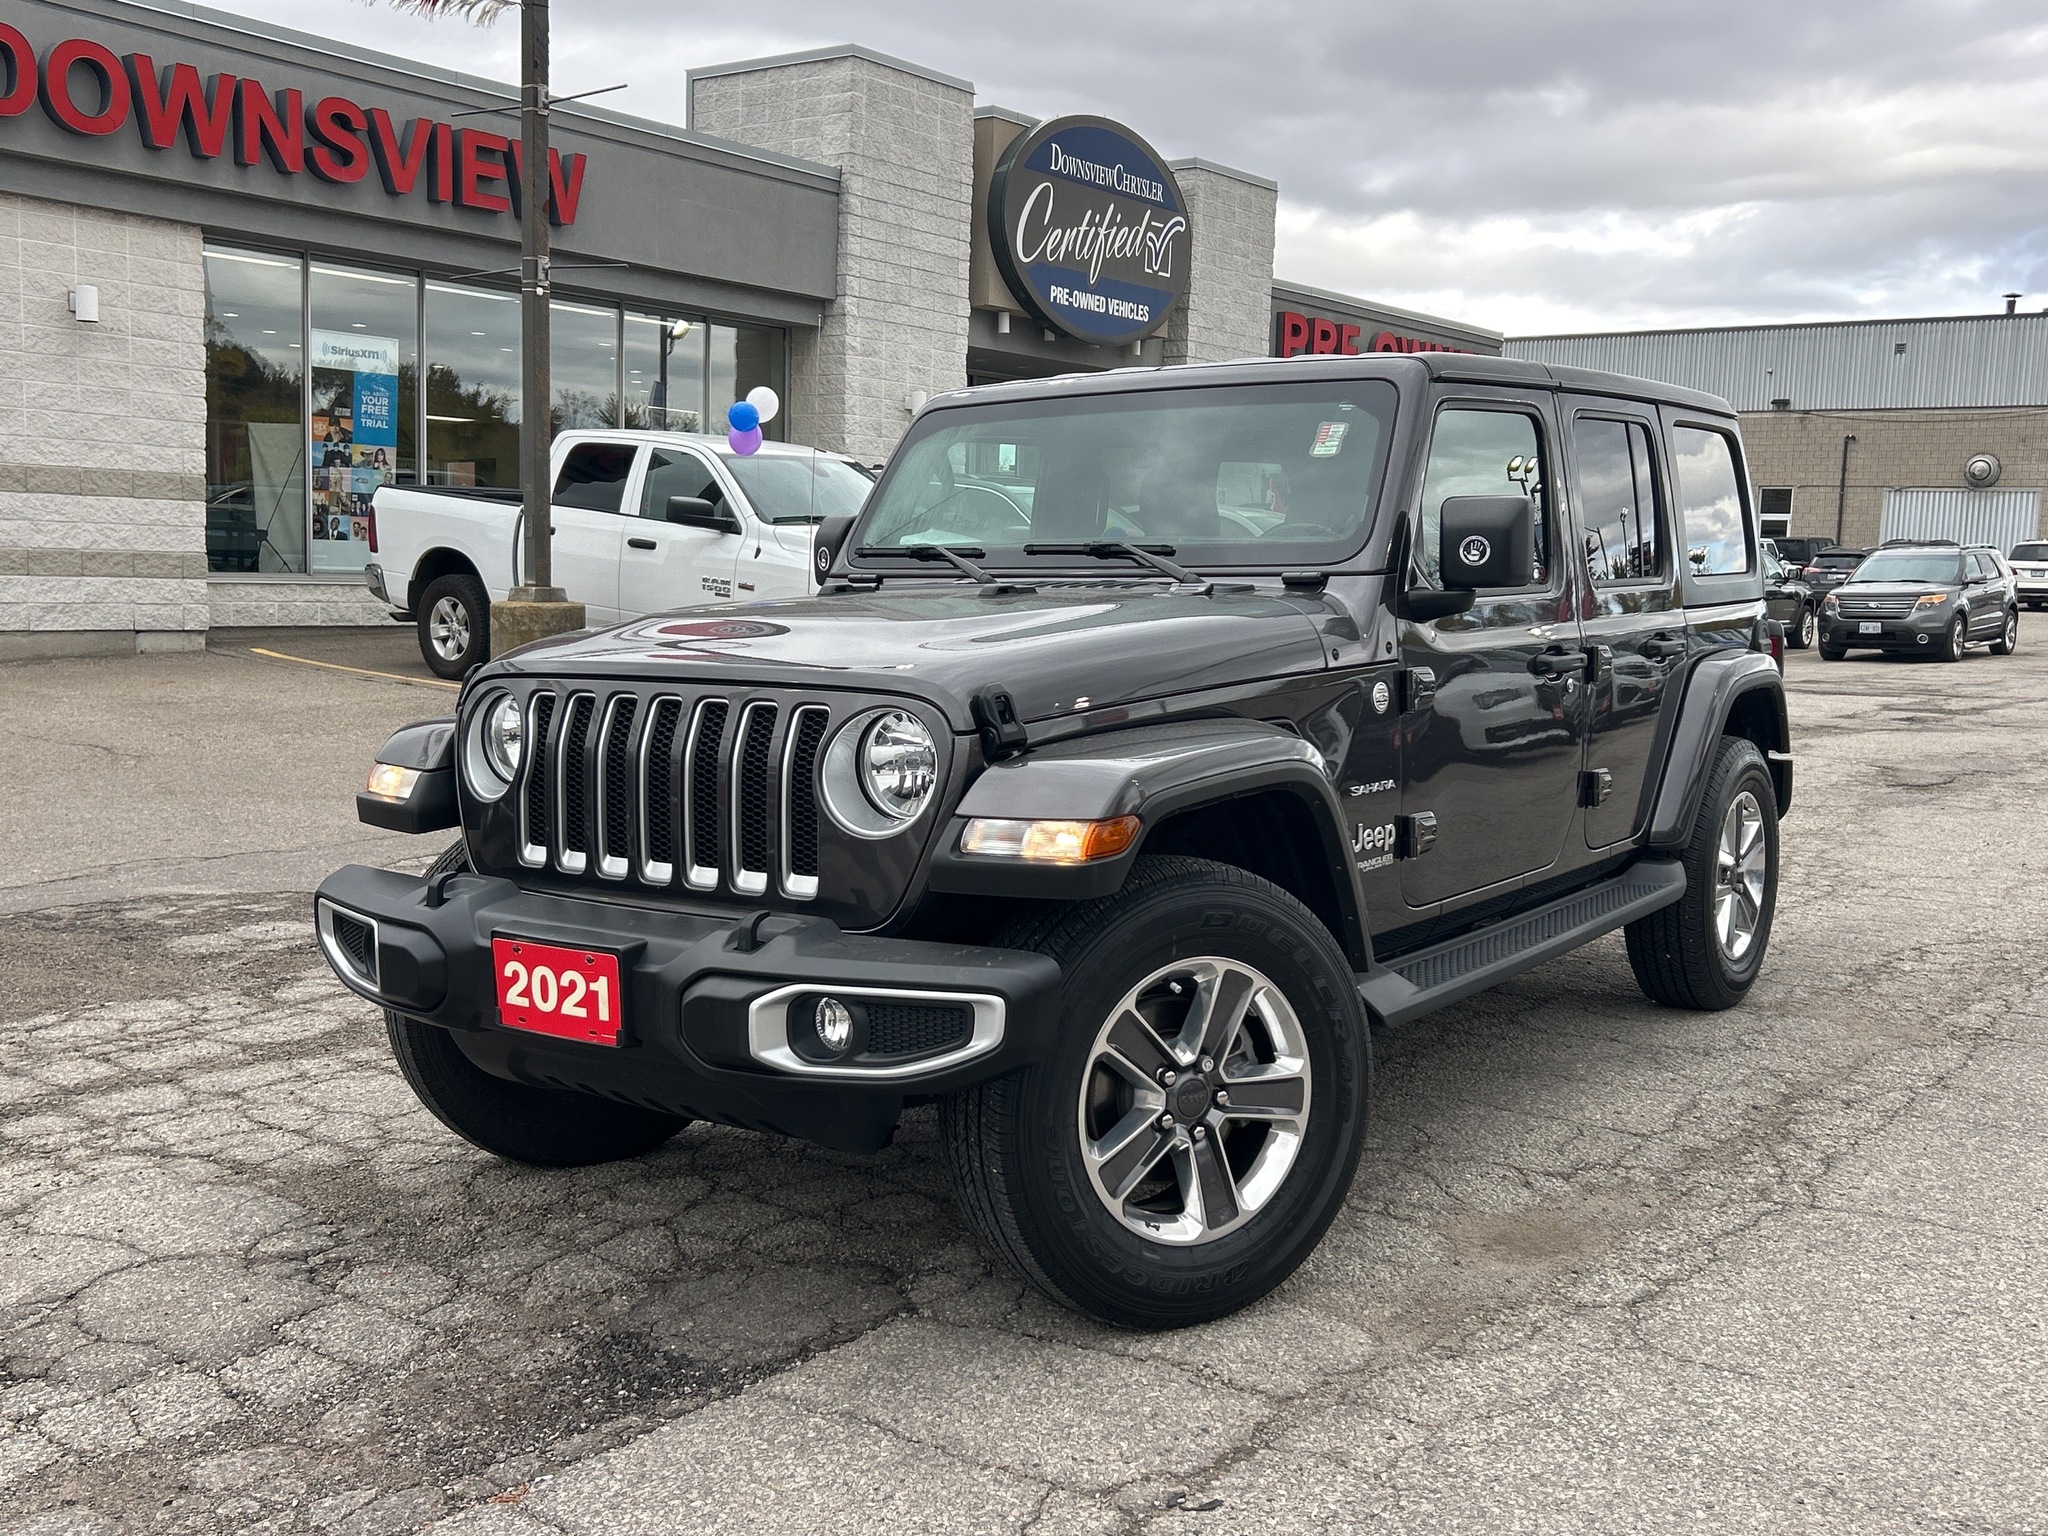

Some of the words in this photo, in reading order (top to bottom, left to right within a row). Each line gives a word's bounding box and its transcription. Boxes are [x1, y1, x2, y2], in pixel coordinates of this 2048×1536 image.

[1016, 182, 1152, 285] Certified
[1050, 285, 1106, 313] PRE-OWNED
[1107, 297, 1150, 322] VEHICLES
[361, 395, 389, 406] YOUR
[361, 404, 389, 415] FREE
[361, 418, 389, 429] TRIAL
[702, 584, 731, 593] 1500
[1350, 779, 1396, 797] SAHARA
[1351, 823, 1396, 852] Jeep
[1357, 853, 1393, 869] RANGLER
[504, 961, 610, 1021] 2021
